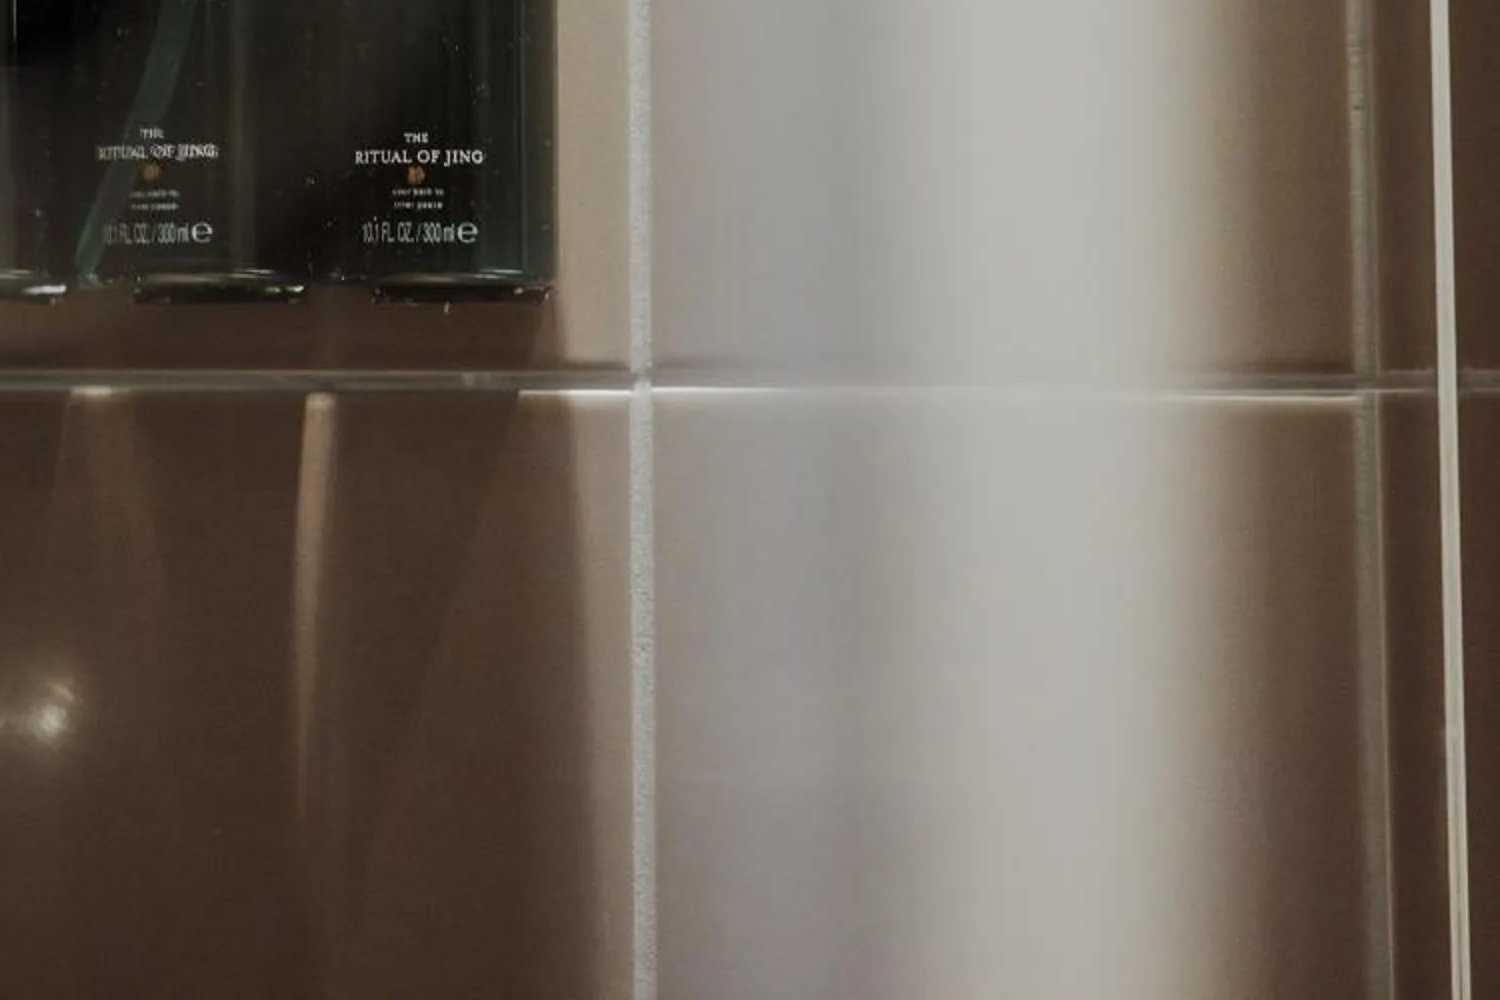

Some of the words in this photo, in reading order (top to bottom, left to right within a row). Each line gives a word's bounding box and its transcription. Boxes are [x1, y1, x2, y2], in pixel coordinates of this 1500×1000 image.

[403, 131, 429, 144] THE
[355, 149, 413, 166] RITUAL
[416, 149, 442, 165] OF
[443, 149, 485, 168] JING
